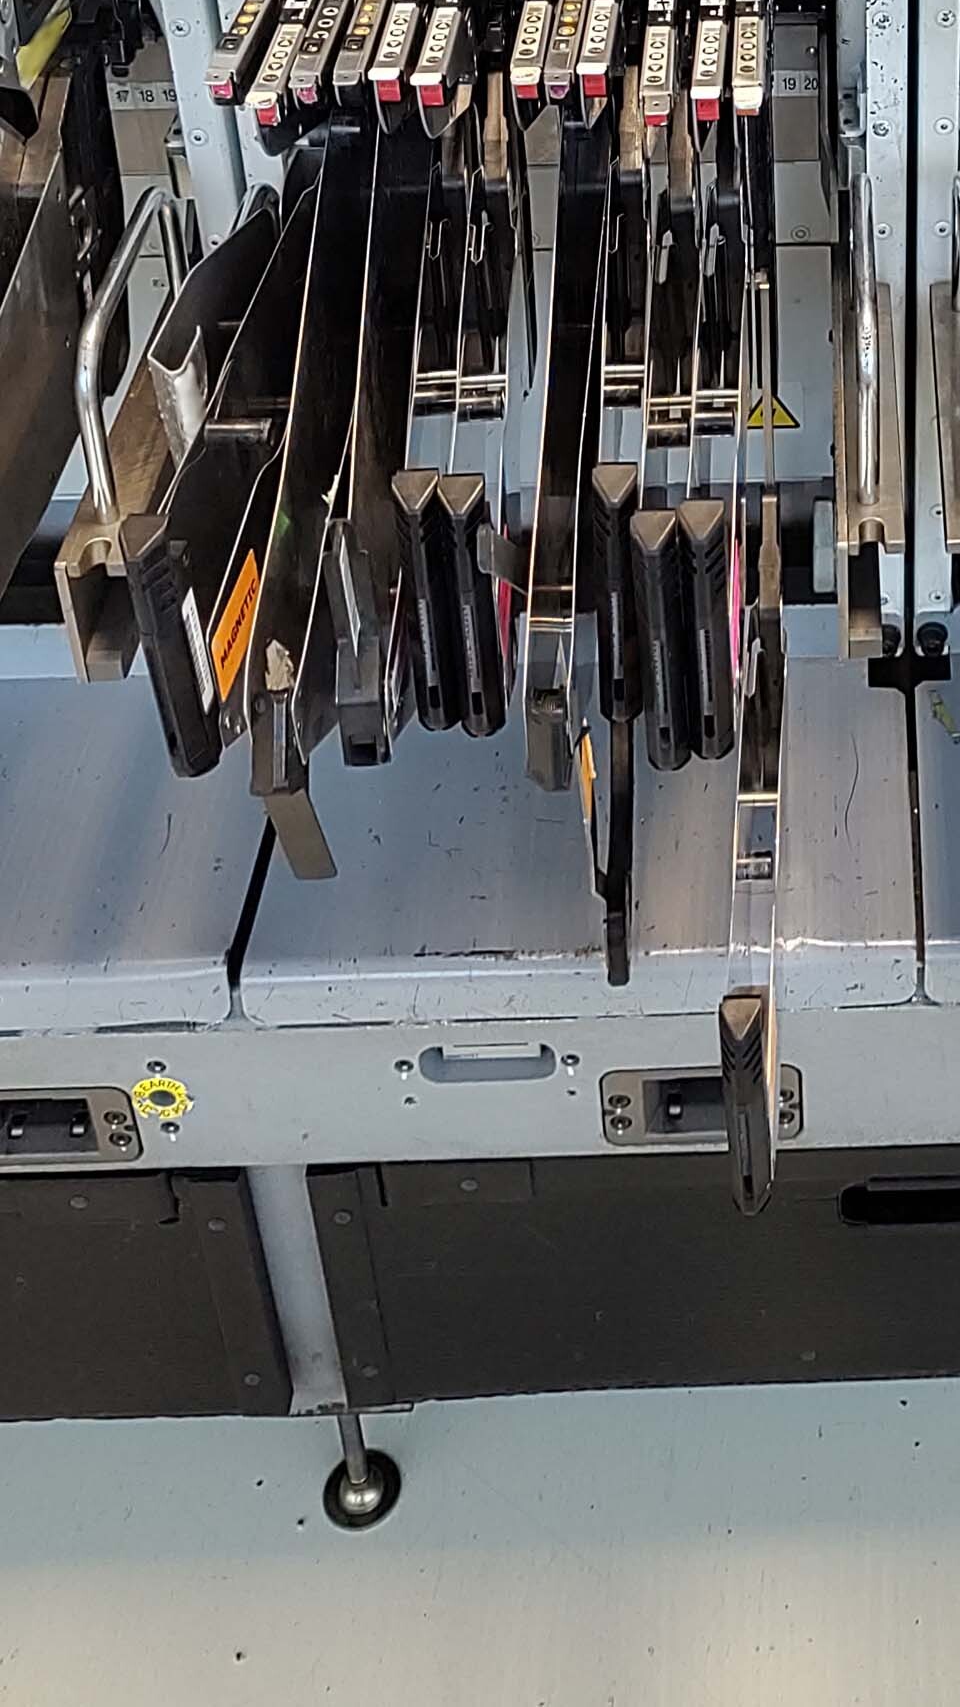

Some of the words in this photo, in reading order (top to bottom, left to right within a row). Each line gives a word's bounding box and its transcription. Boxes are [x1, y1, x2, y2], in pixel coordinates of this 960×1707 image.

[783, 77, 797, 90] 19
[804, 77, 818, 90] 20
[115, 90, 129, 102] 17
[139, 89, 155, 103] 18
[162, 89, 177, 102] 19
[220, 578, 257, 670] MAGNETIC
